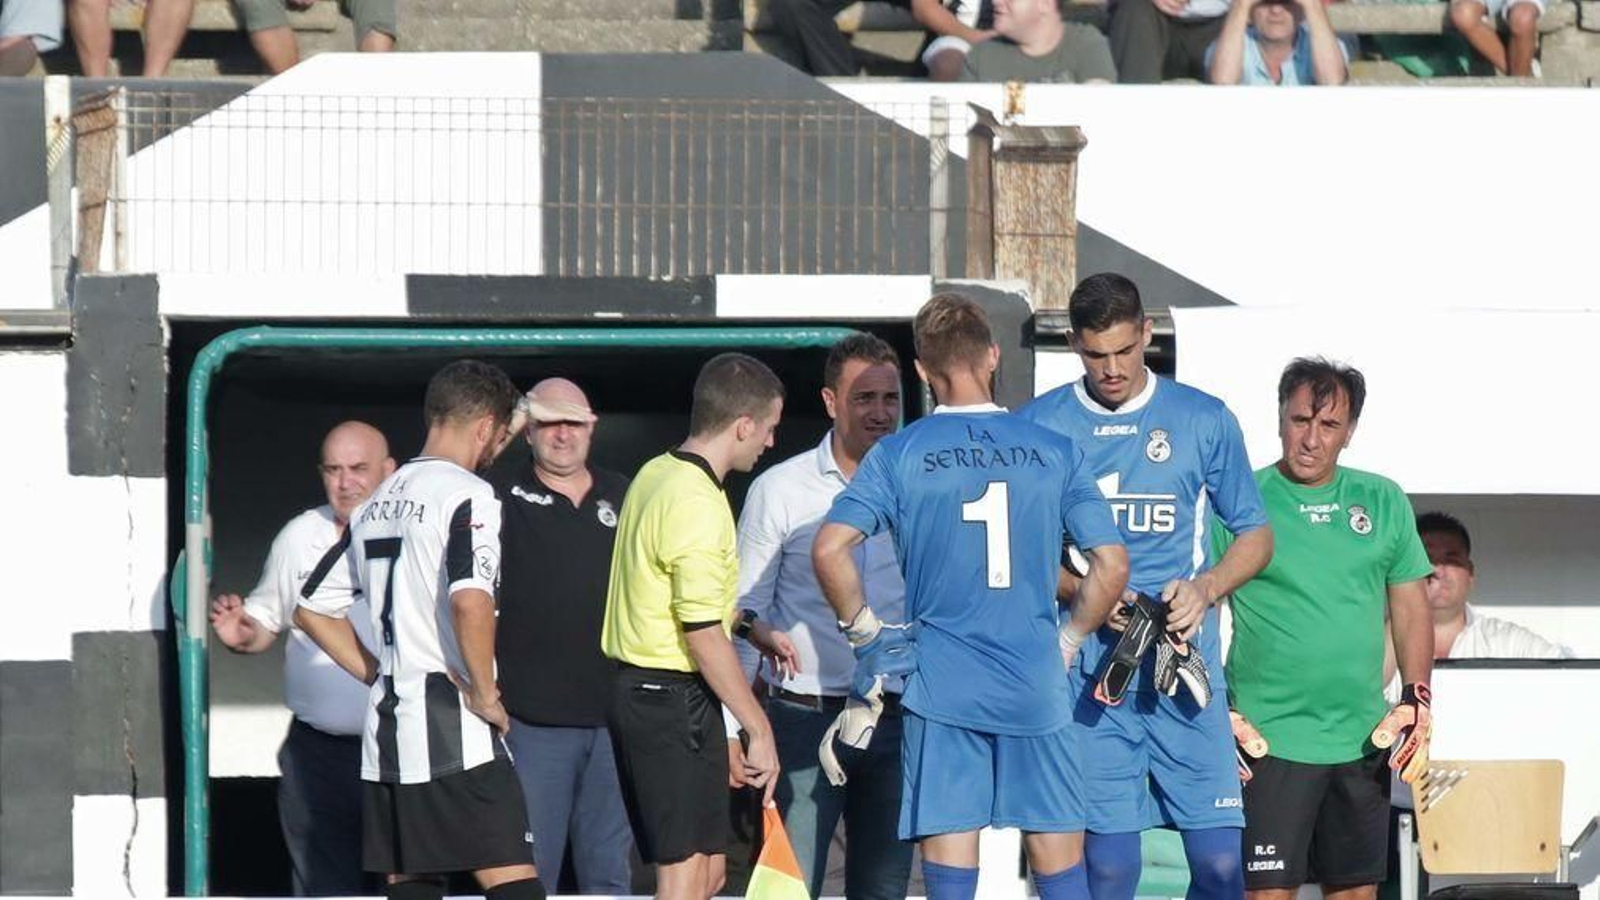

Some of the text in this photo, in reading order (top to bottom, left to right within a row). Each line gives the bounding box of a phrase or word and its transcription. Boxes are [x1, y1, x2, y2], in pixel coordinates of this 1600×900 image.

[966, 424, 996, 443] LA
[1093, 424, 1139, 436] LEGEA
[1110, 503, 1176, 532] TUS
[962, 480, 1011, 589] 1
[364, 537, 403, 645] 7
[1254, 844, 1276, 855] R.C
[1247, 860, 1284, 872] LEGEA
